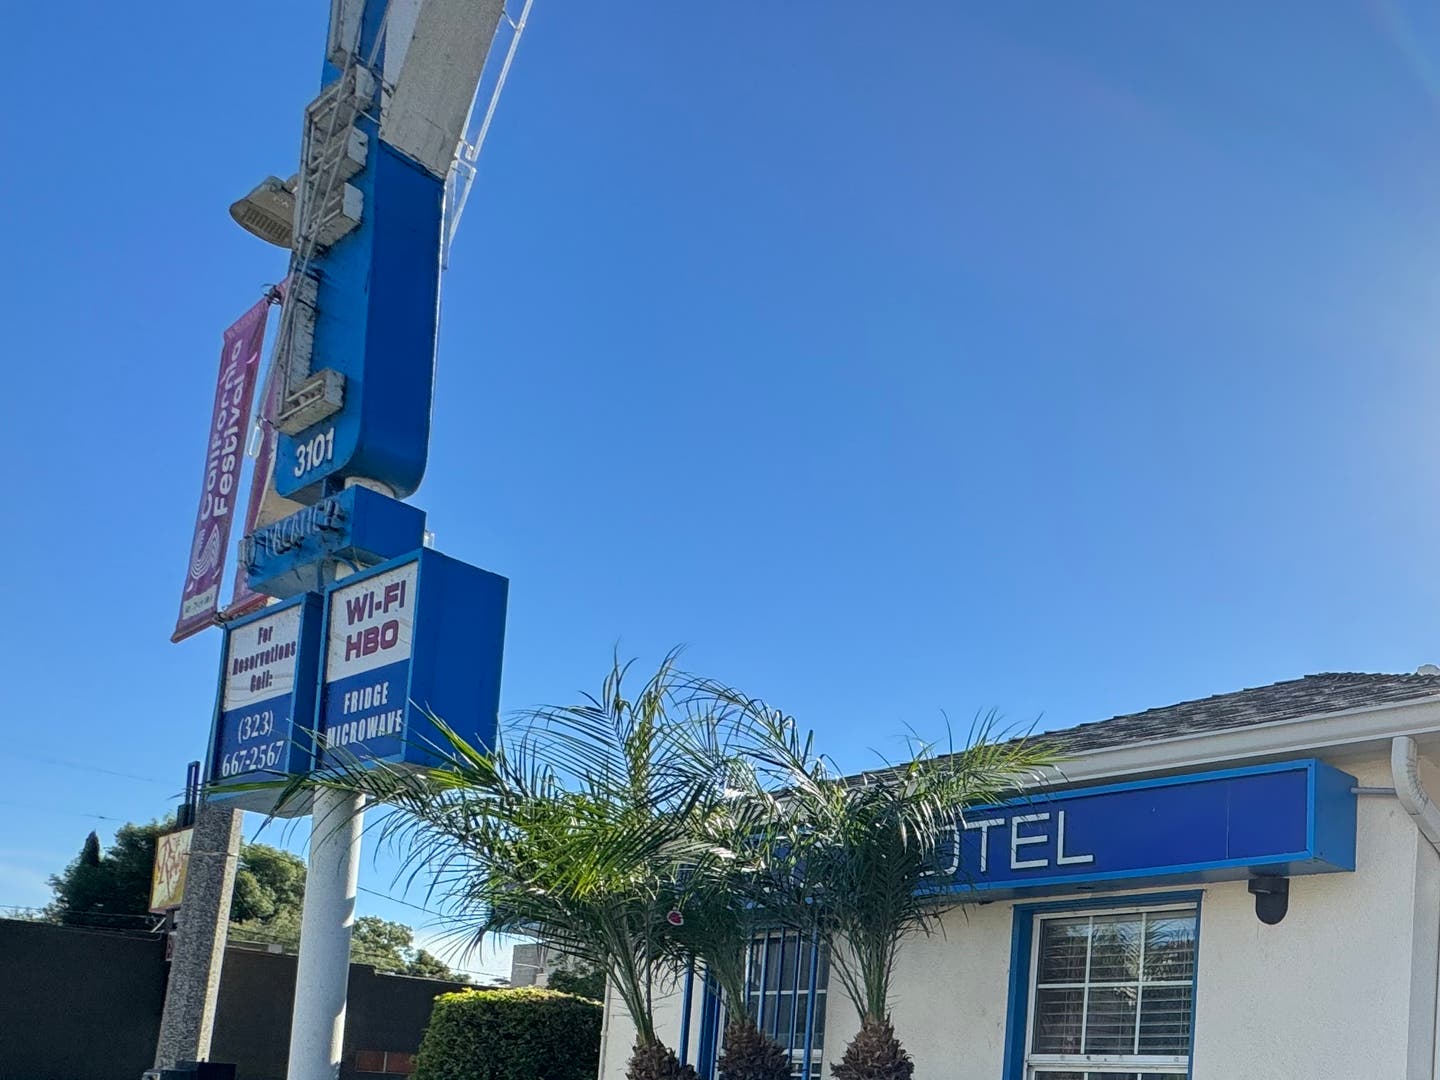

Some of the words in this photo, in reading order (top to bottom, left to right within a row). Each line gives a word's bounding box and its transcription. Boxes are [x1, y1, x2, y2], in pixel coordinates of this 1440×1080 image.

[201, 339, 242, 522] California
[213, 373, 245, 518] Festival
[294, 427, 335, 477] 3101
[346, 579, 407, 626] WI-FI
[257, 626, 274, 646] For
[344, 619, 400, 662] HBO
[232, 640, 297, 676] Reservations
[250, 669, 273, 694] Call:
[343, 681, 389, 715] FRIDGE
[237, 710, 274, 745] (323)
[326, 708, 403, 750] MICROWAVE
[222, 740, 285, 778] 667-2567
